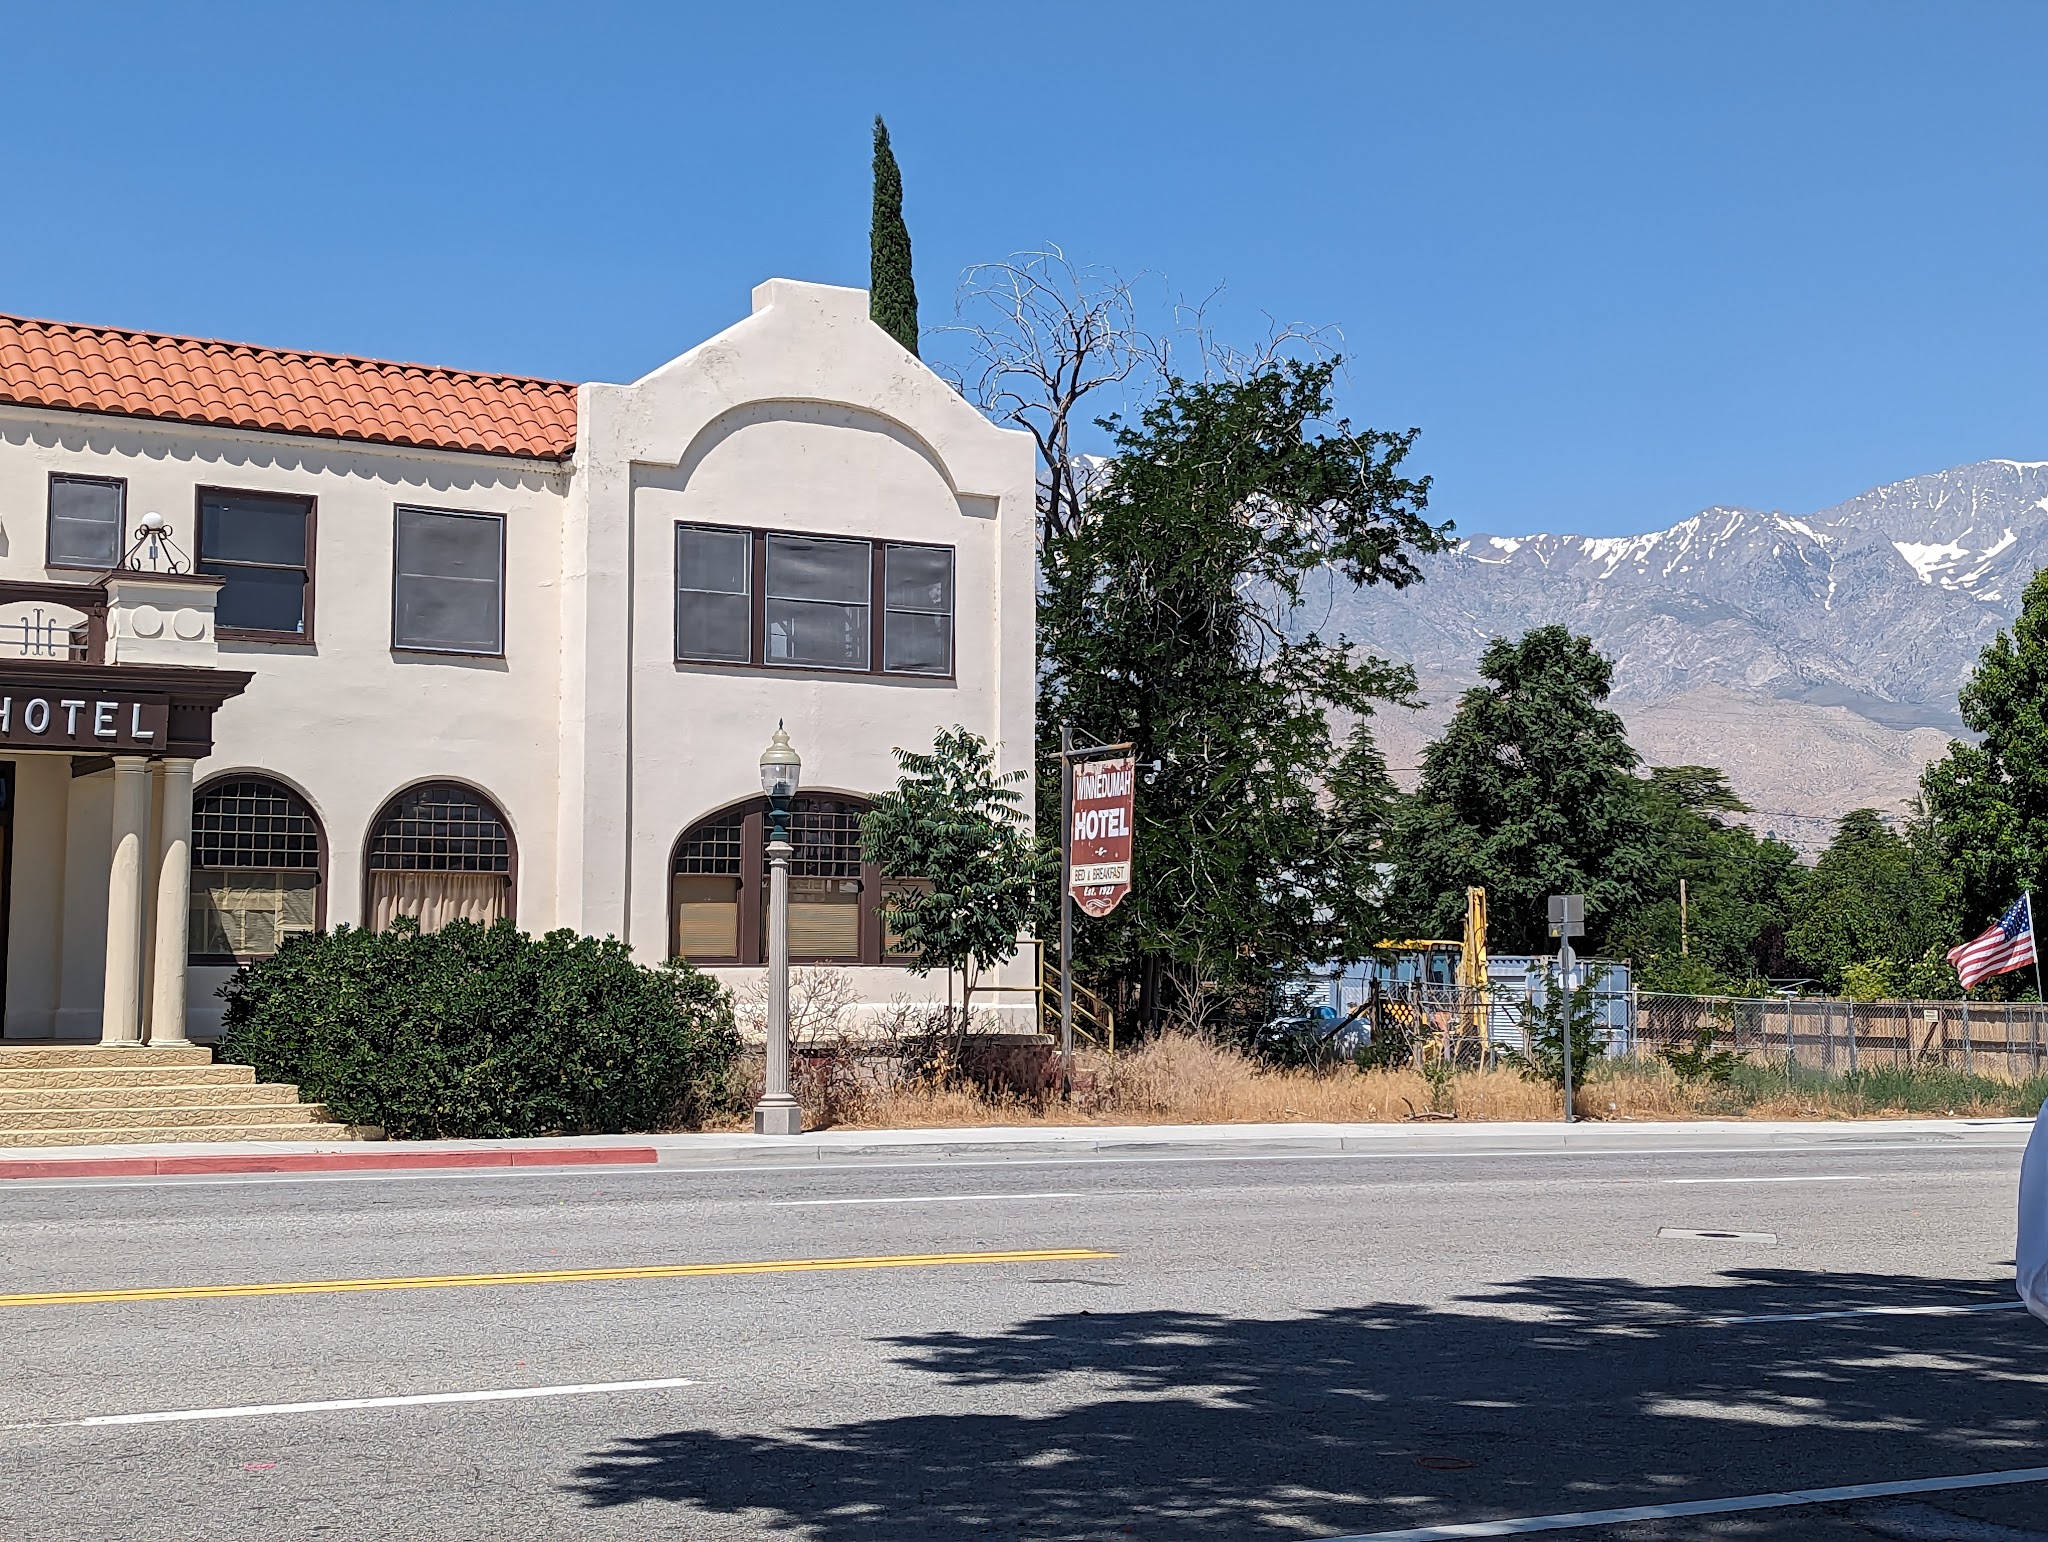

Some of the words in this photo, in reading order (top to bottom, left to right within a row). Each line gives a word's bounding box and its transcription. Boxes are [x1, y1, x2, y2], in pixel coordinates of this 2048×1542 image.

[1076, 771, 1131, 800] WINNEDUMAH
[1075, 808, 1129, 840] HOTEL
[1075, 869, 1085, 881] BED
[1092, 866, 1125, 880] BREAKFAST
